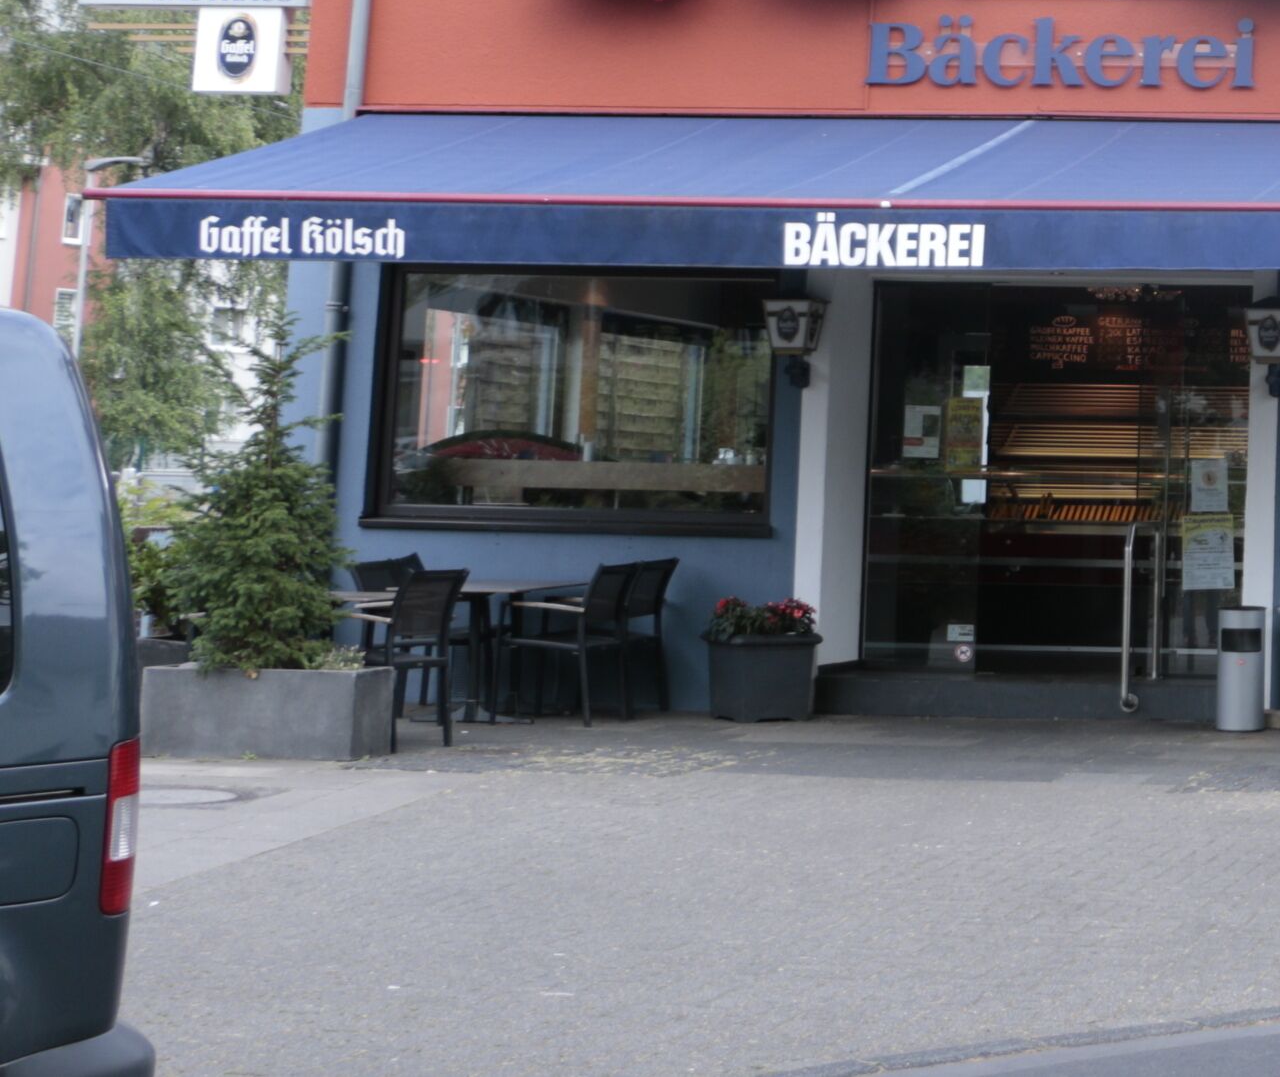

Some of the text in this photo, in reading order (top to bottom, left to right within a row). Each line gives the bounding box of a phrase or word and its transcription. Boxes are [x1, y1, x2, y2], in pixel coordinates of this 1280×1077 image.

[865, 14, 1256, 89] Bäckerei
[200, 215, 406, 259] Gaffel Kölsch
[783, 212, 986, 267] BÄCKEREI
